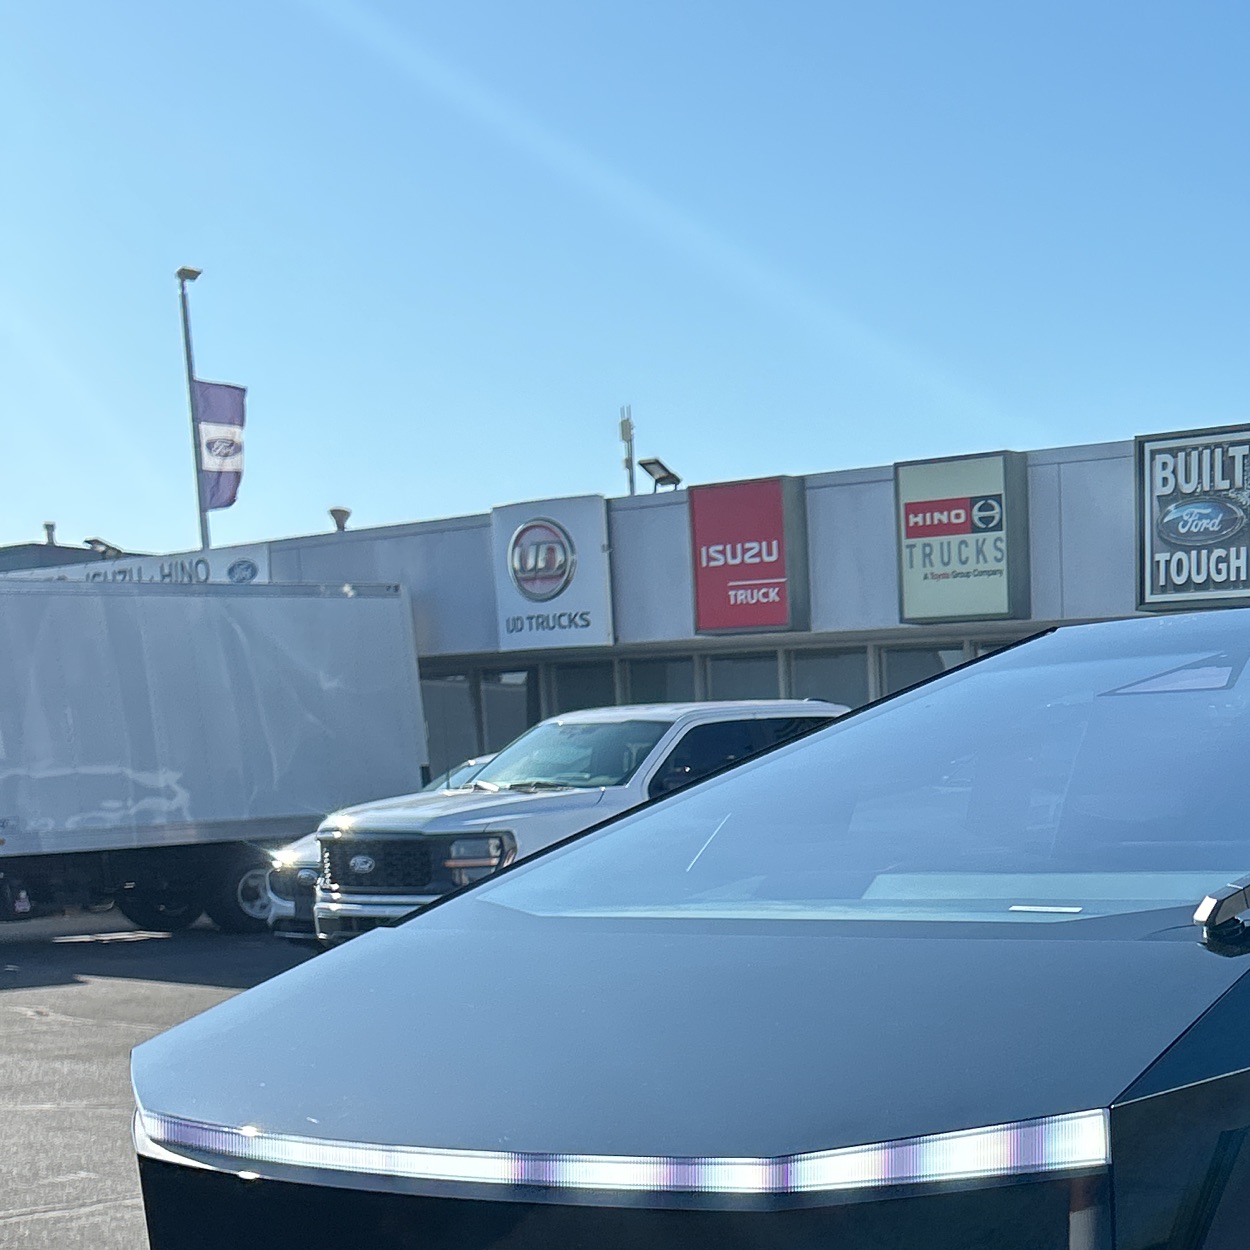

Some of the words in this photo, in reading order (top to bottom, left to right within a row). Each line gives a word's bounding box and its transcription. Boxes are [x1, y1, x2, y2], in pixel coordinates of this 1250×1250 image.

[1155, 445, 1250, 496] BUILT
[909, 509, 966, 527] HINO
[1178, 508, 1223, 534] Ford
[512, 542, 567, 578] UD
[701, 540, 778, 568] ISUZU
[906, 537, 1004, 569] TRUCKS
[1154, 547, 1247, 586] TOUGH
[159, 558, 210, 583] HINO
[727, 587, 780, 605] TRUCK
[506, 616, 524, 634] UD
[525, 611, 591, 631] TRUCKS
